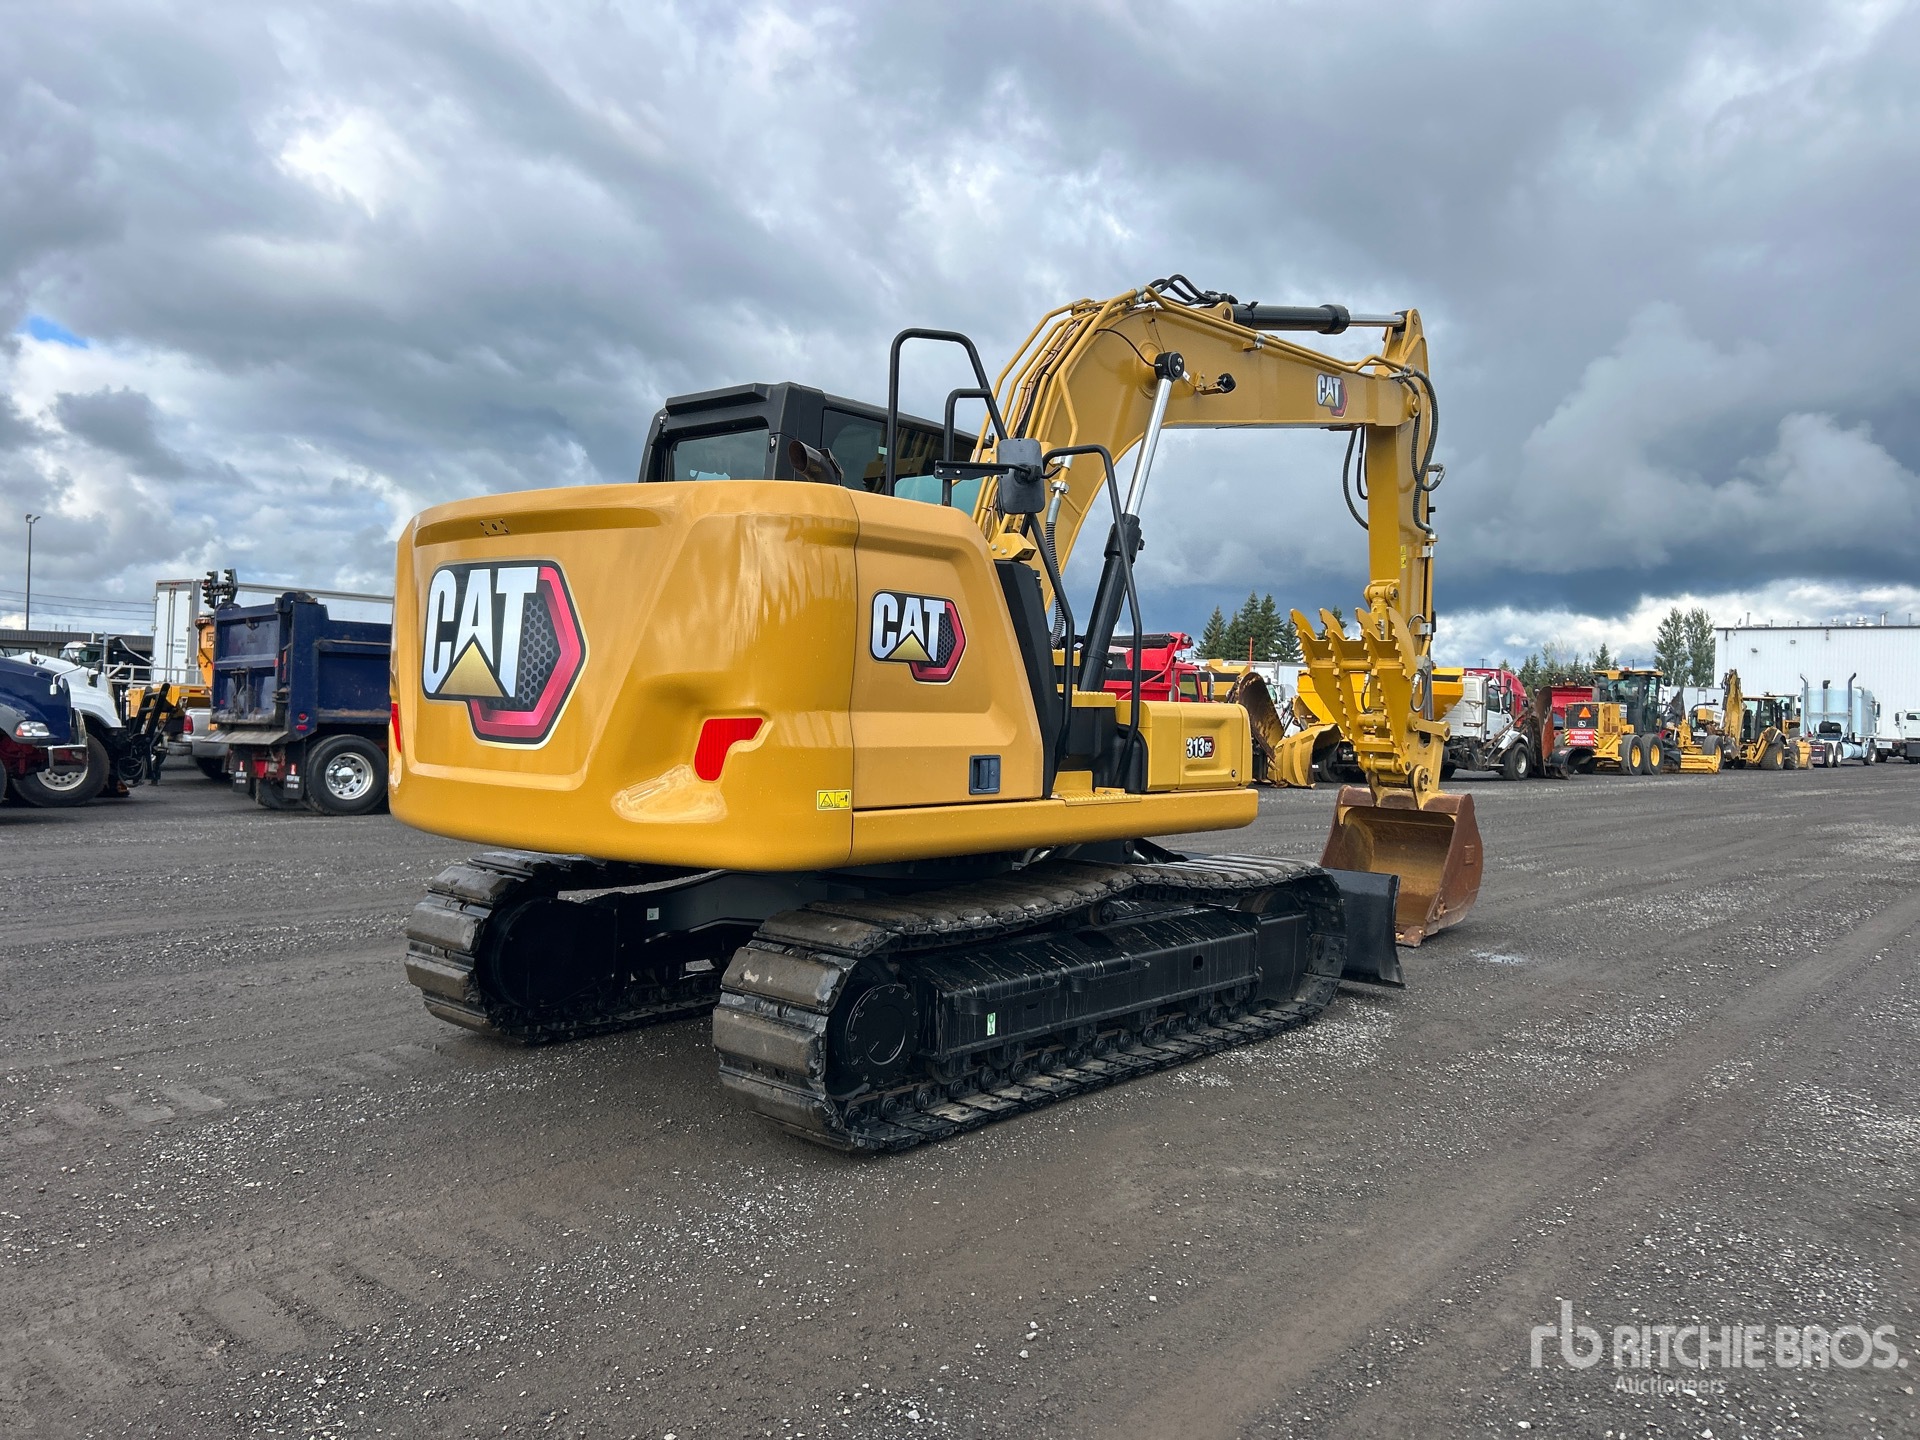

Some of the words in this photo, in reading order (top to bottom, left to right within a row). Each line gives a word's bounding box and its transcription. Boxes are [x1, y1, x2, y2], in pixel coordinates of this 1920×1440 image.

[1317, 374, 1341, 407] CAT
[423, 566, 539, 698] CAT
[872, 593, 946, 662] CAT
[1187, 737, 1204, 757] 313
